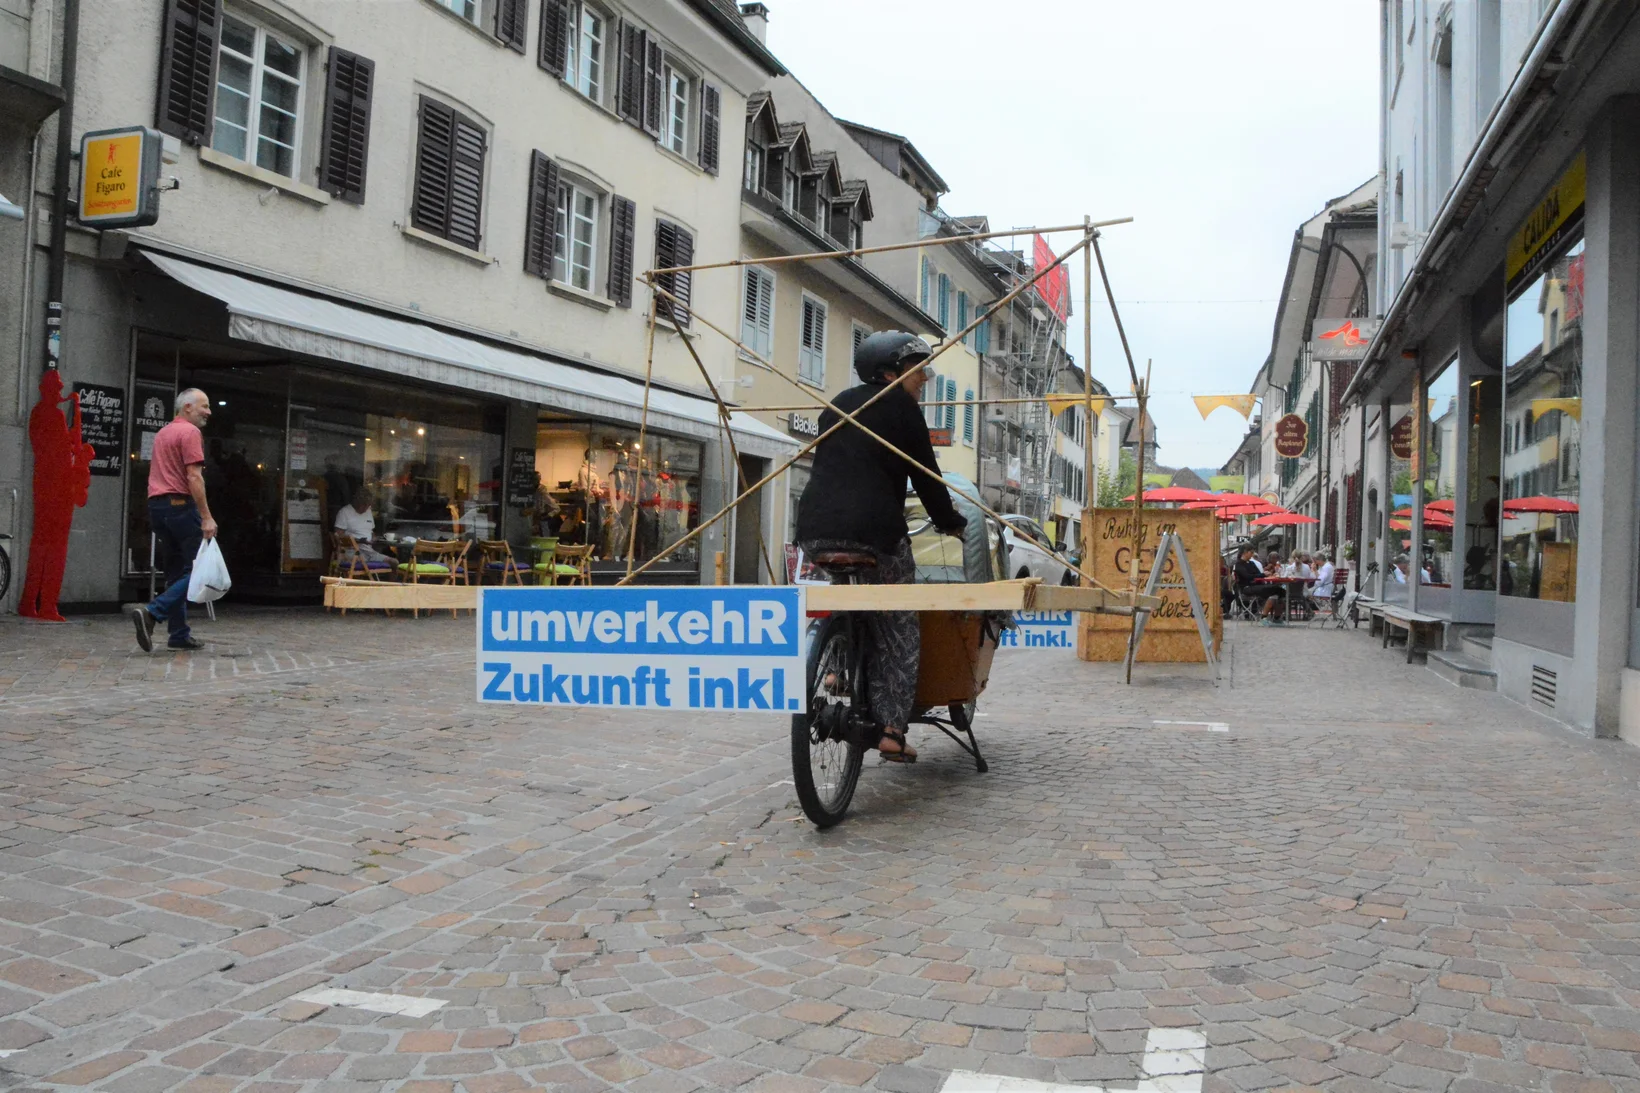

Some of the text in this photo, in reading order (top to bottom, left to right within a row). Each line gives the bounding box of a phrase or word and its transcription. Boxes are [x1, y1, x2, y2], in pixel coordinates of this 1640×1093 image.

[96, 182, 126, 195] Figaro
[1524, 188, 1560, 254] CALIDA
[96, 391, 121, 409] Figaro
[492, 601, 788, 645] umverkehR
[1025, 630, 1072, 648] inkl.
[483, 663, 799, 711] Zukunft inkl.
